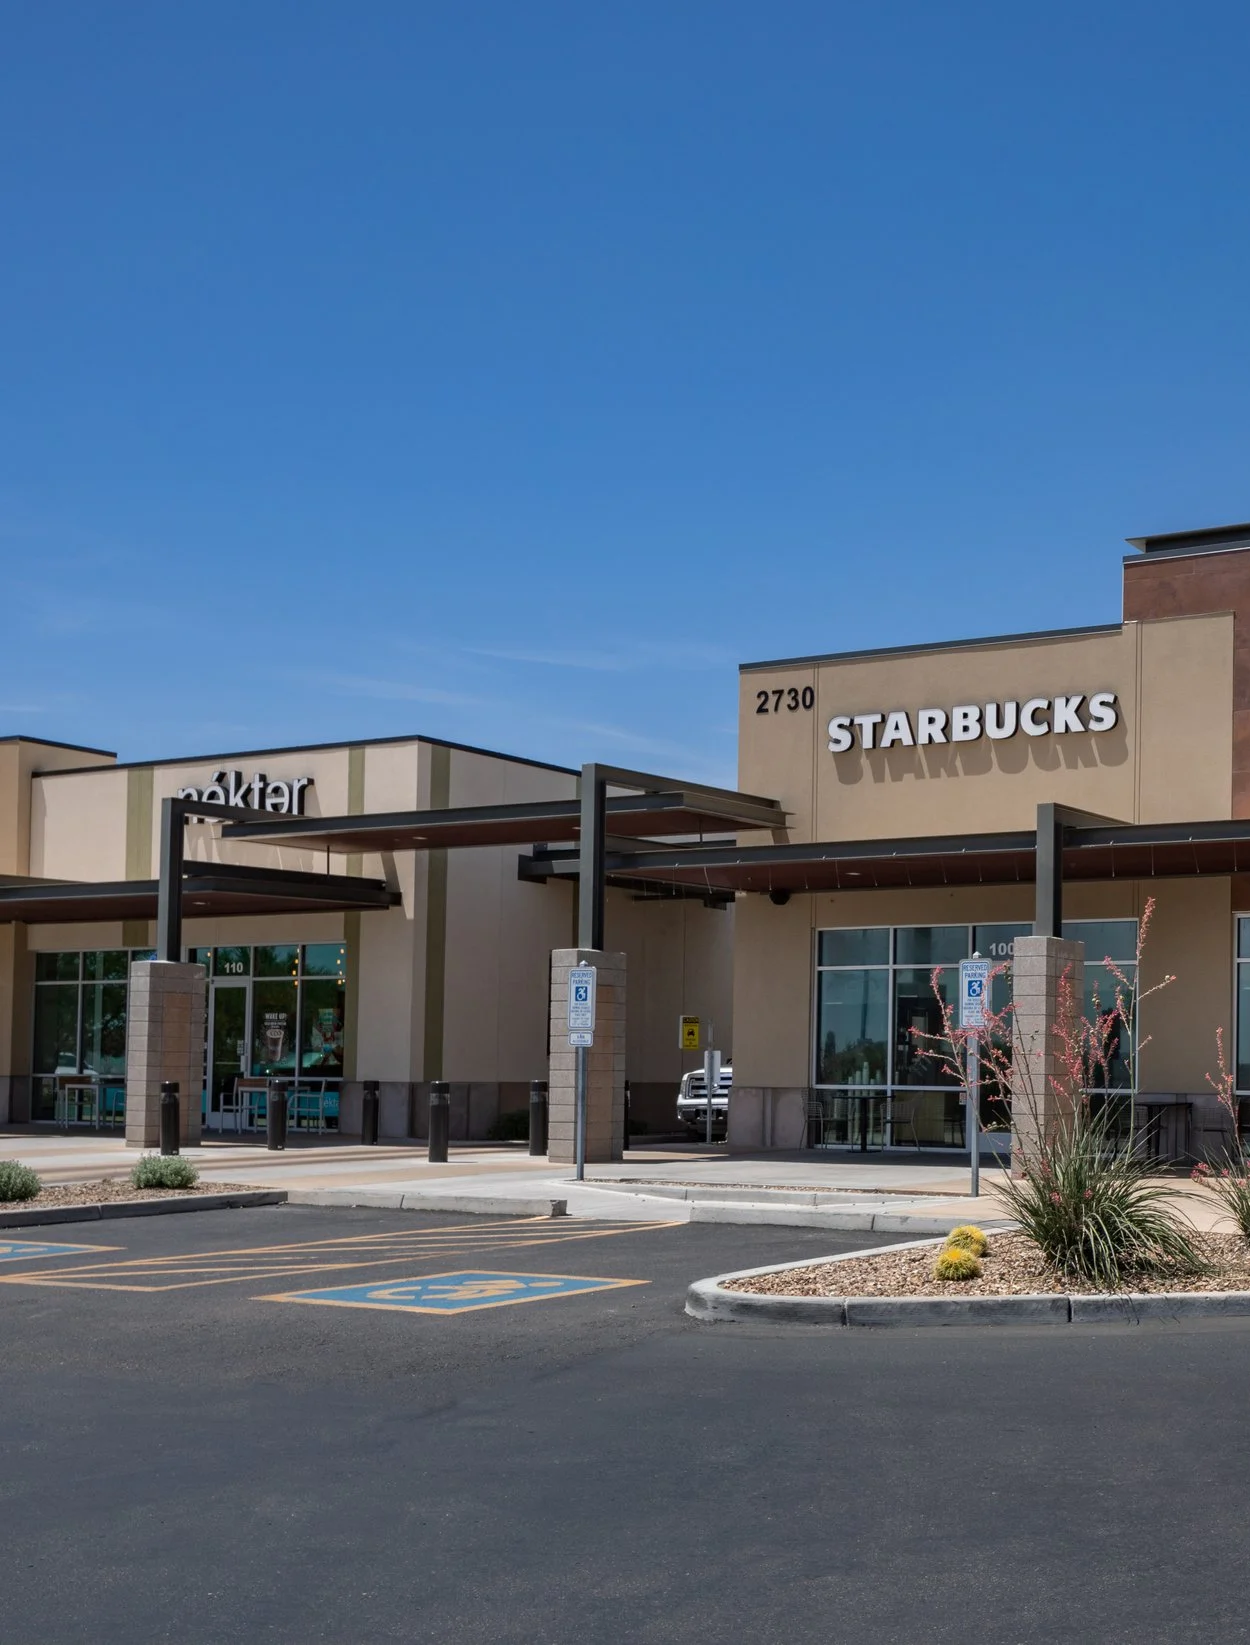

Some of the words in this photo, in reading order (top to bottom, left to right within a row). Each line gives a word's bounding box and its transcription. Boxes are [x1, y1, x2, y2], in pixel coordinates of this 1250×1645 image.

[756, 686, 815, 714] 2730
[827, 692, 1119, 753] STARBUCKS
[224, 962, 244, 973] 110
